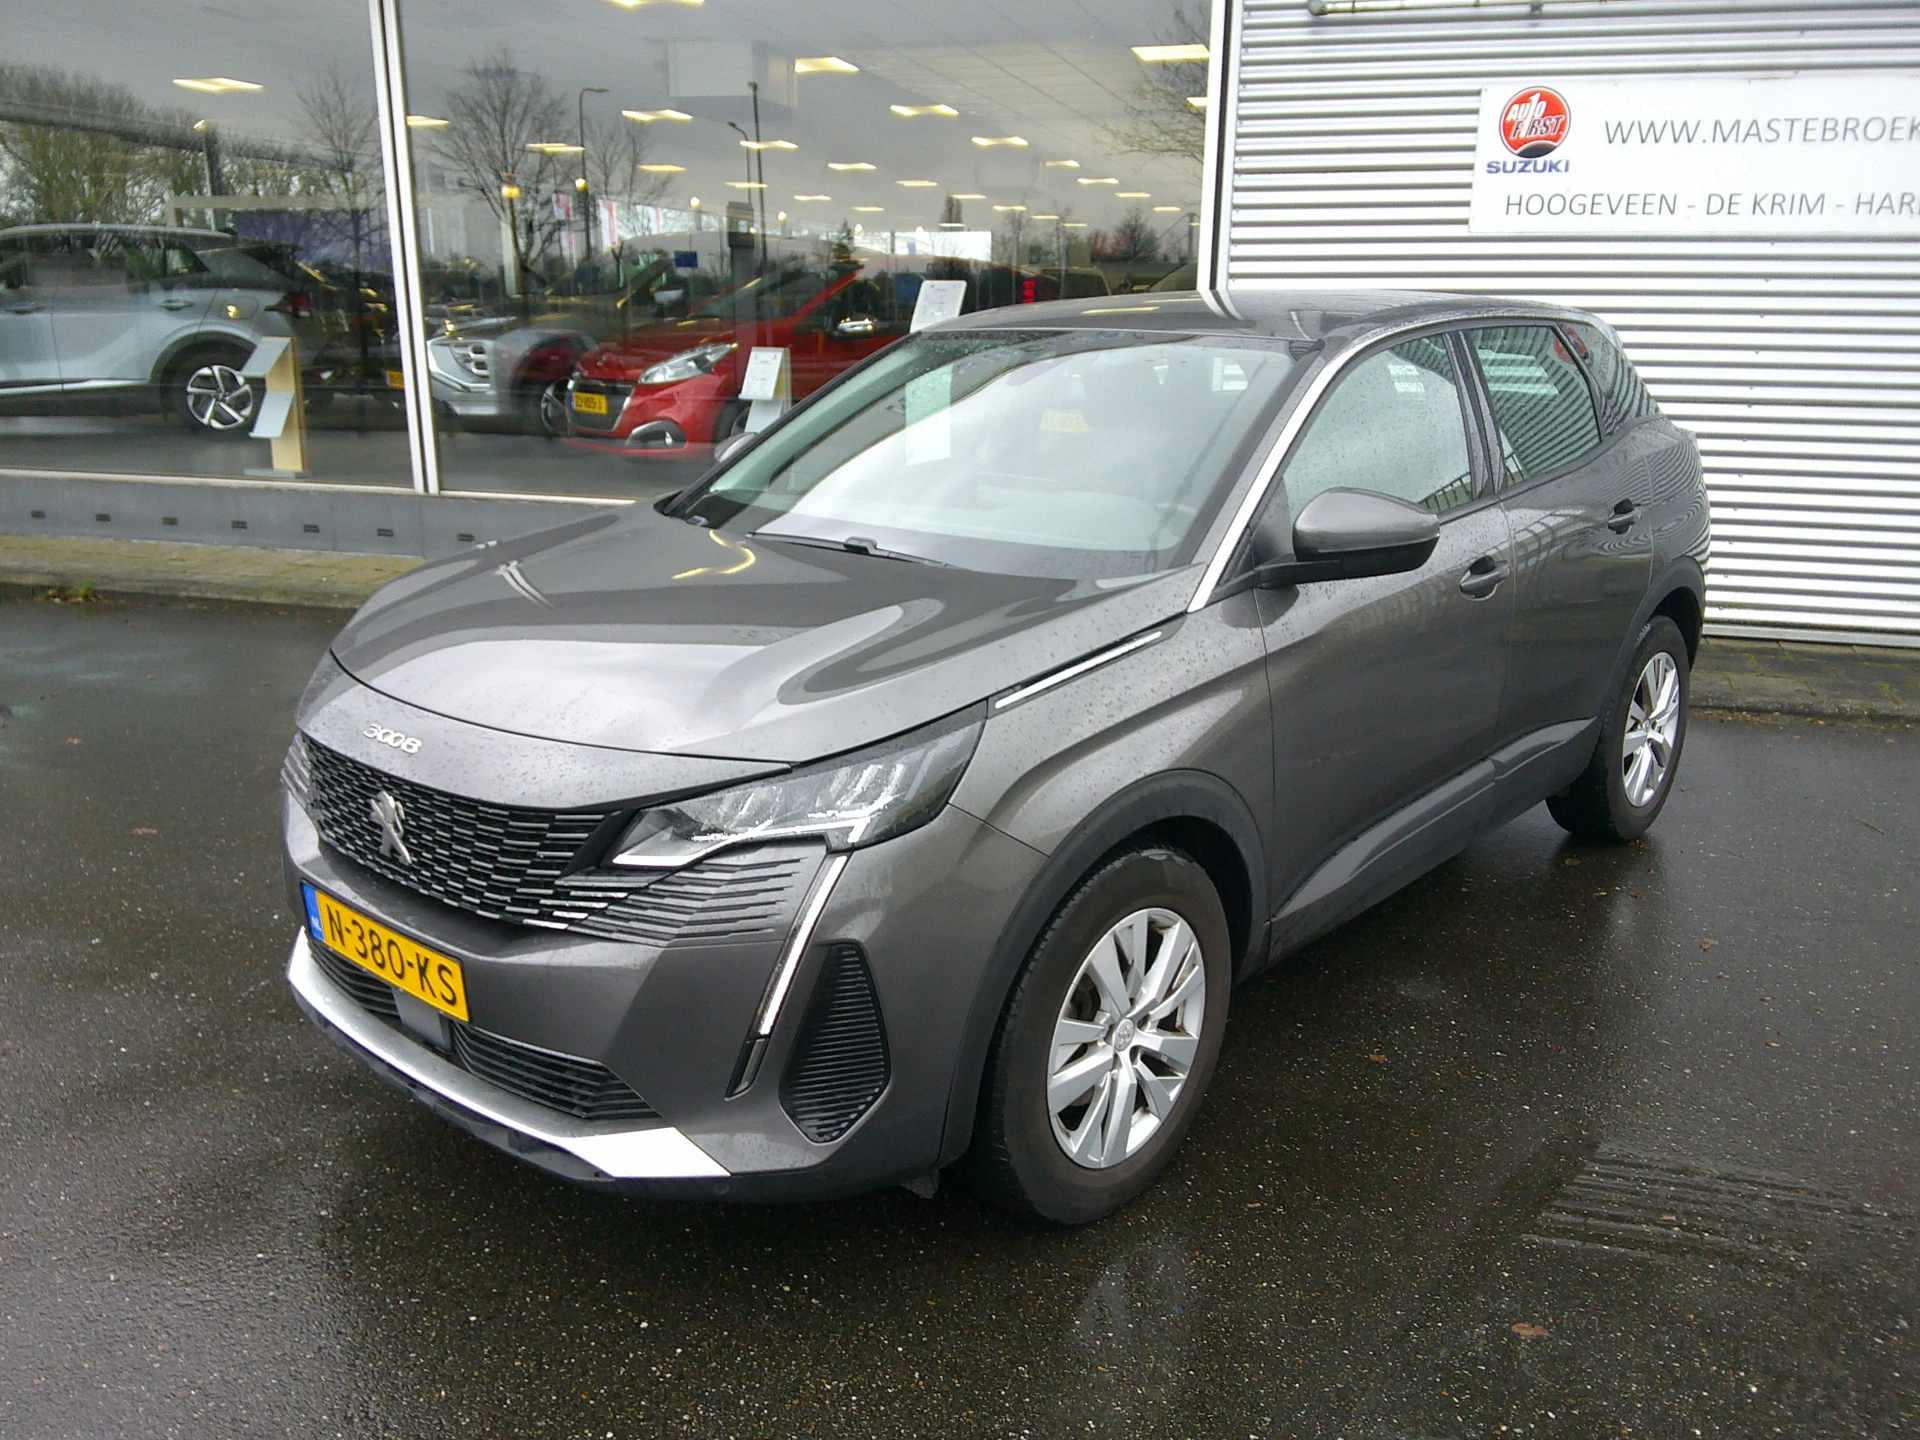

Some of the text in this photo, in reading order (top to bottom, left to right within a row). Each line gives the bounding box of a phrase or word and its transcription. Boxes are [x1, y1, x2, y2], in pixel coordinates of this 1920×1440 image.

[1604, 116, 1920, 144] WWW.MASTEBROEK
[1486, 160, 1571, 174] SUZUKI
[1505, 193, 1677, 215] HOOGEVEEN
[1706, 193, 1742, 215] DE
[1752, 192, 1826, 215] KRIM
[1855, 192, 1920, 215] HAR
[363, 723, 422, 754] 3008
[326, 903, 457, 1007] N-380-KS
